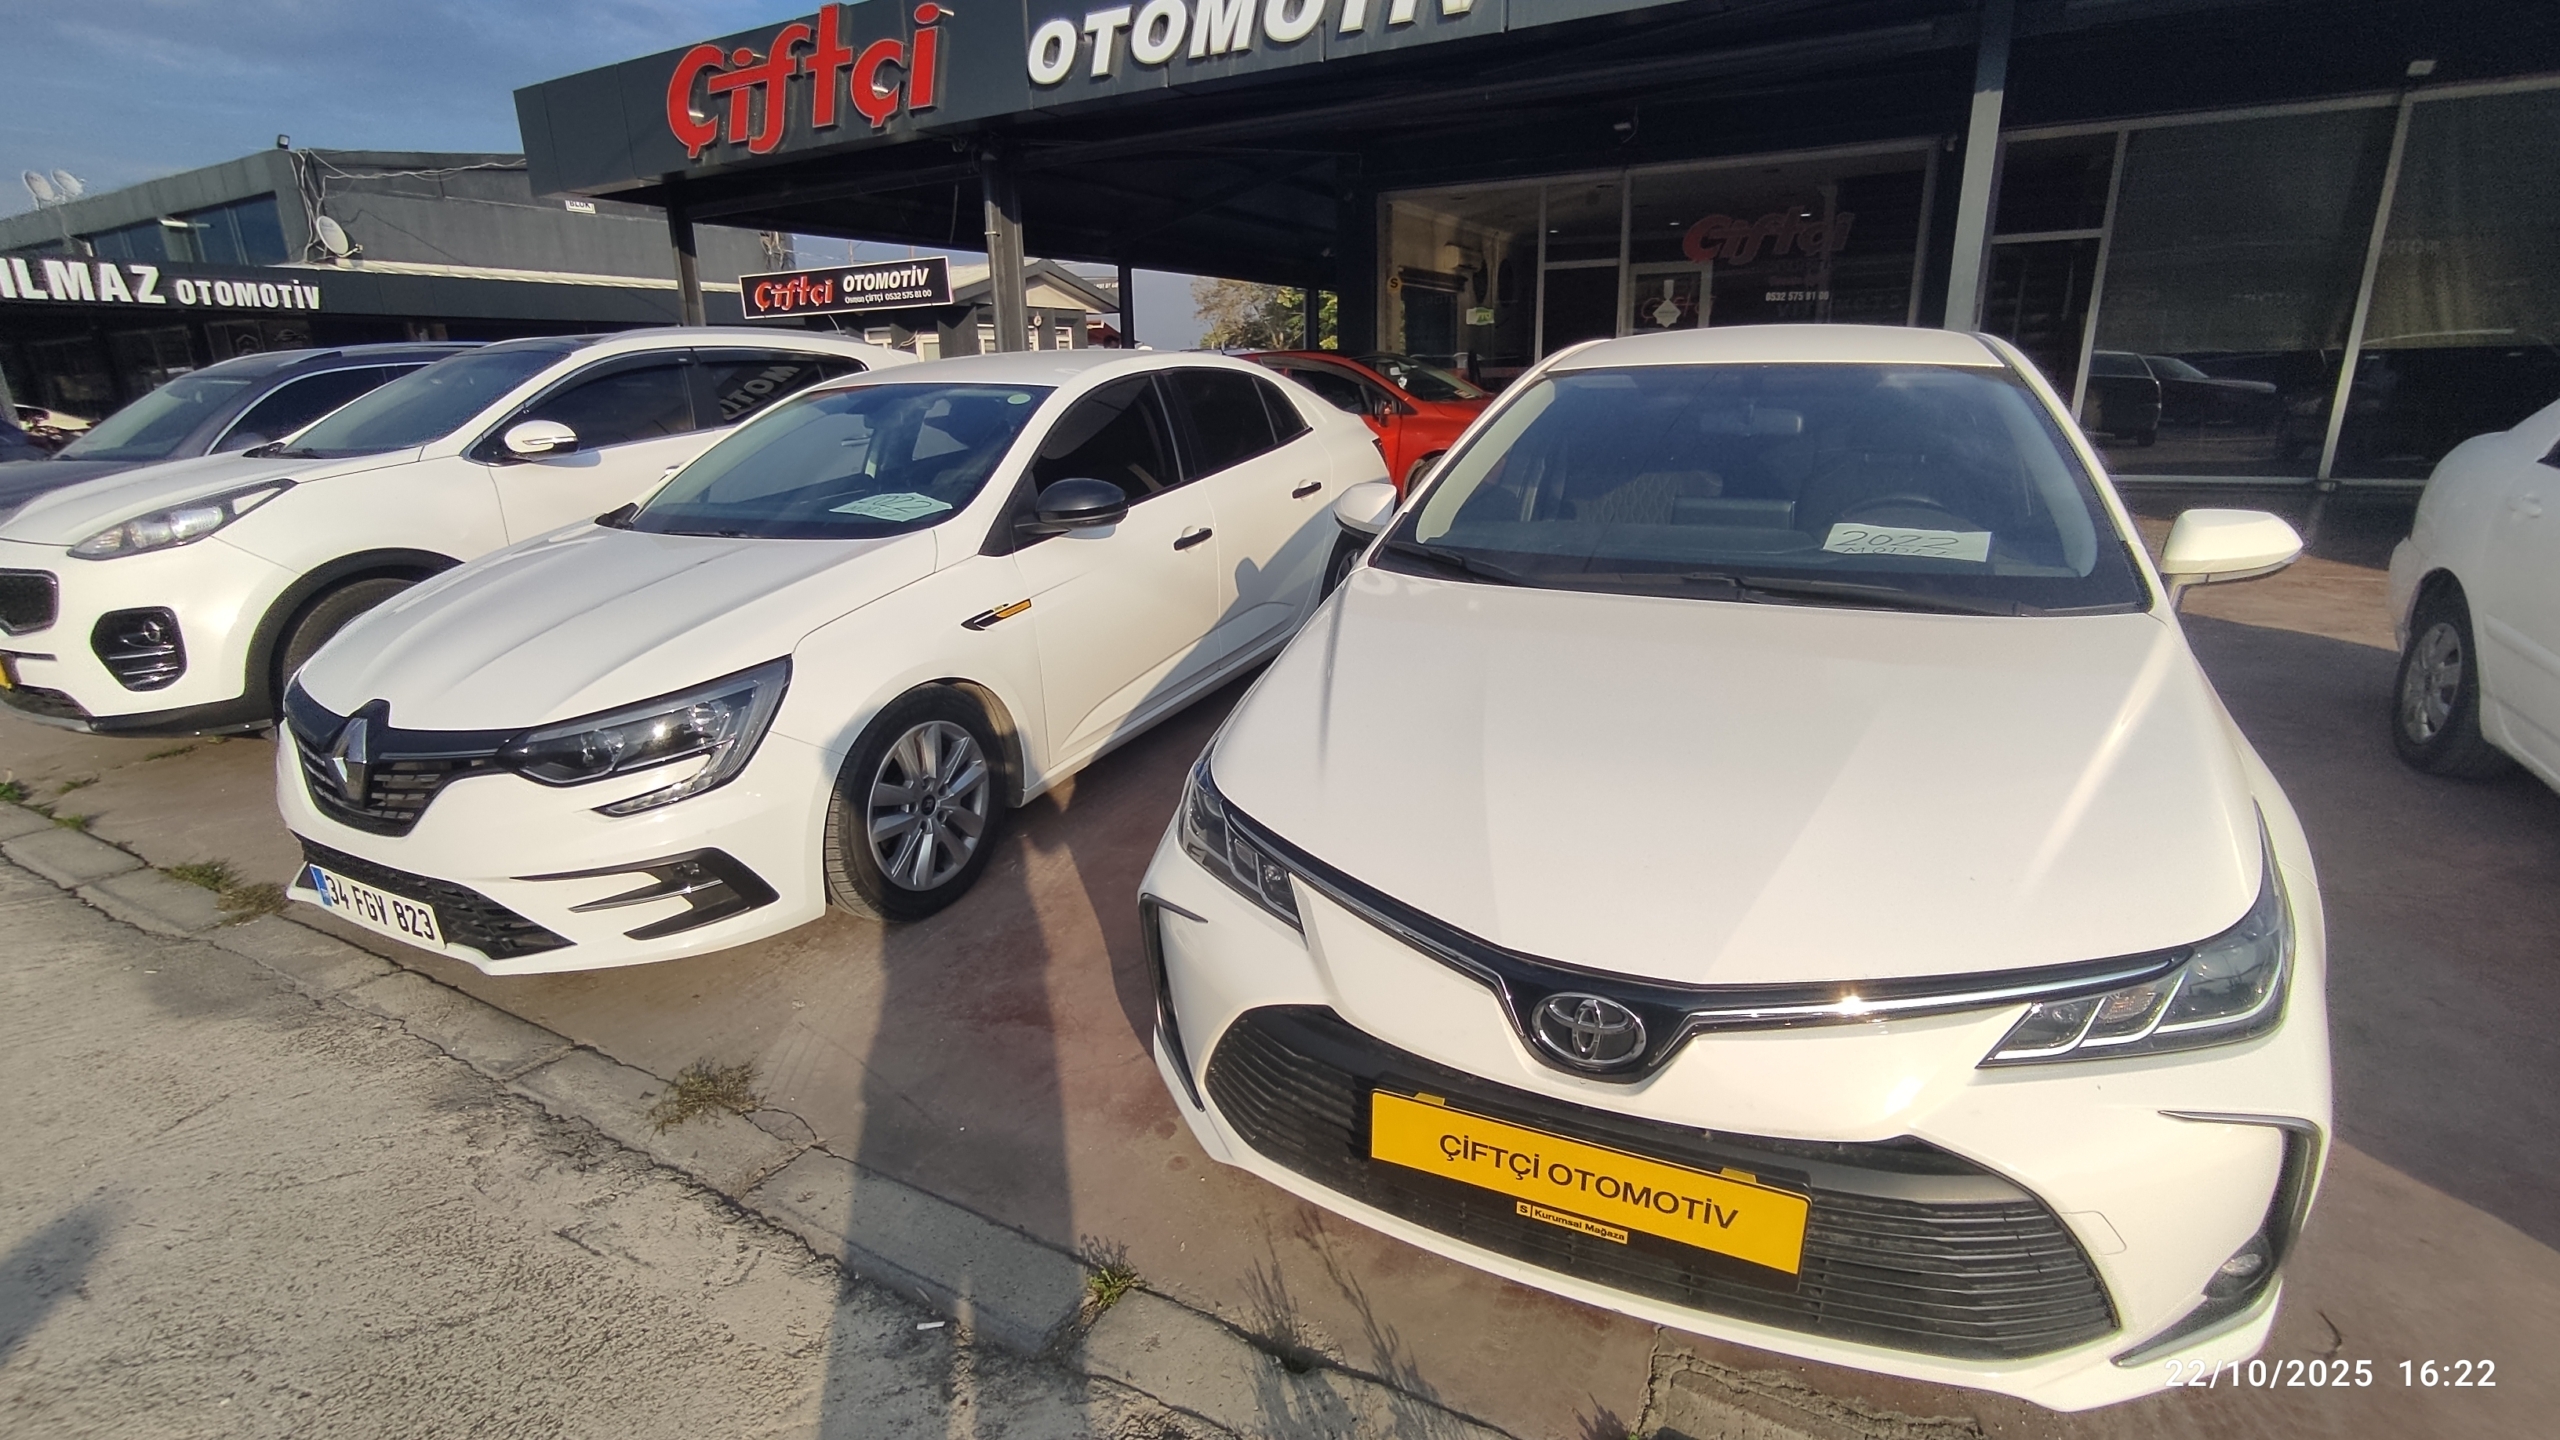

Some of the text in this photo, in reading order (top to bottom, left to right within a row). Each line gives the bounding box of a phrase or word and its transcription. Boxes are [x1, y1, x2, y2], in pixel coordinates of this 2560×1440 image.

[667, 0, 1473, 158] Çiftçi OTOMO
[176, 279, 320, 310] OTOMOTİV
[754, 265, 929, 312] Çiftçi OTOMOTİV
[885, 292, 901, 301] 0532
[902, 291, 914, 300] 575
[923, 289, 932, 298] 00
[1390, 278, 1399, 288] S
[1834, 530, 1959, 549] 2022
[325, 875, 435, 941] 34 FGV 823
[1439, 1134, 1739, 1230] ÇİFTÇİ OTOMOTİV
[1519, 1204, 1528, 1214] S
[1534, 1209, 1625, 1241] Kurumsal Mağaza
